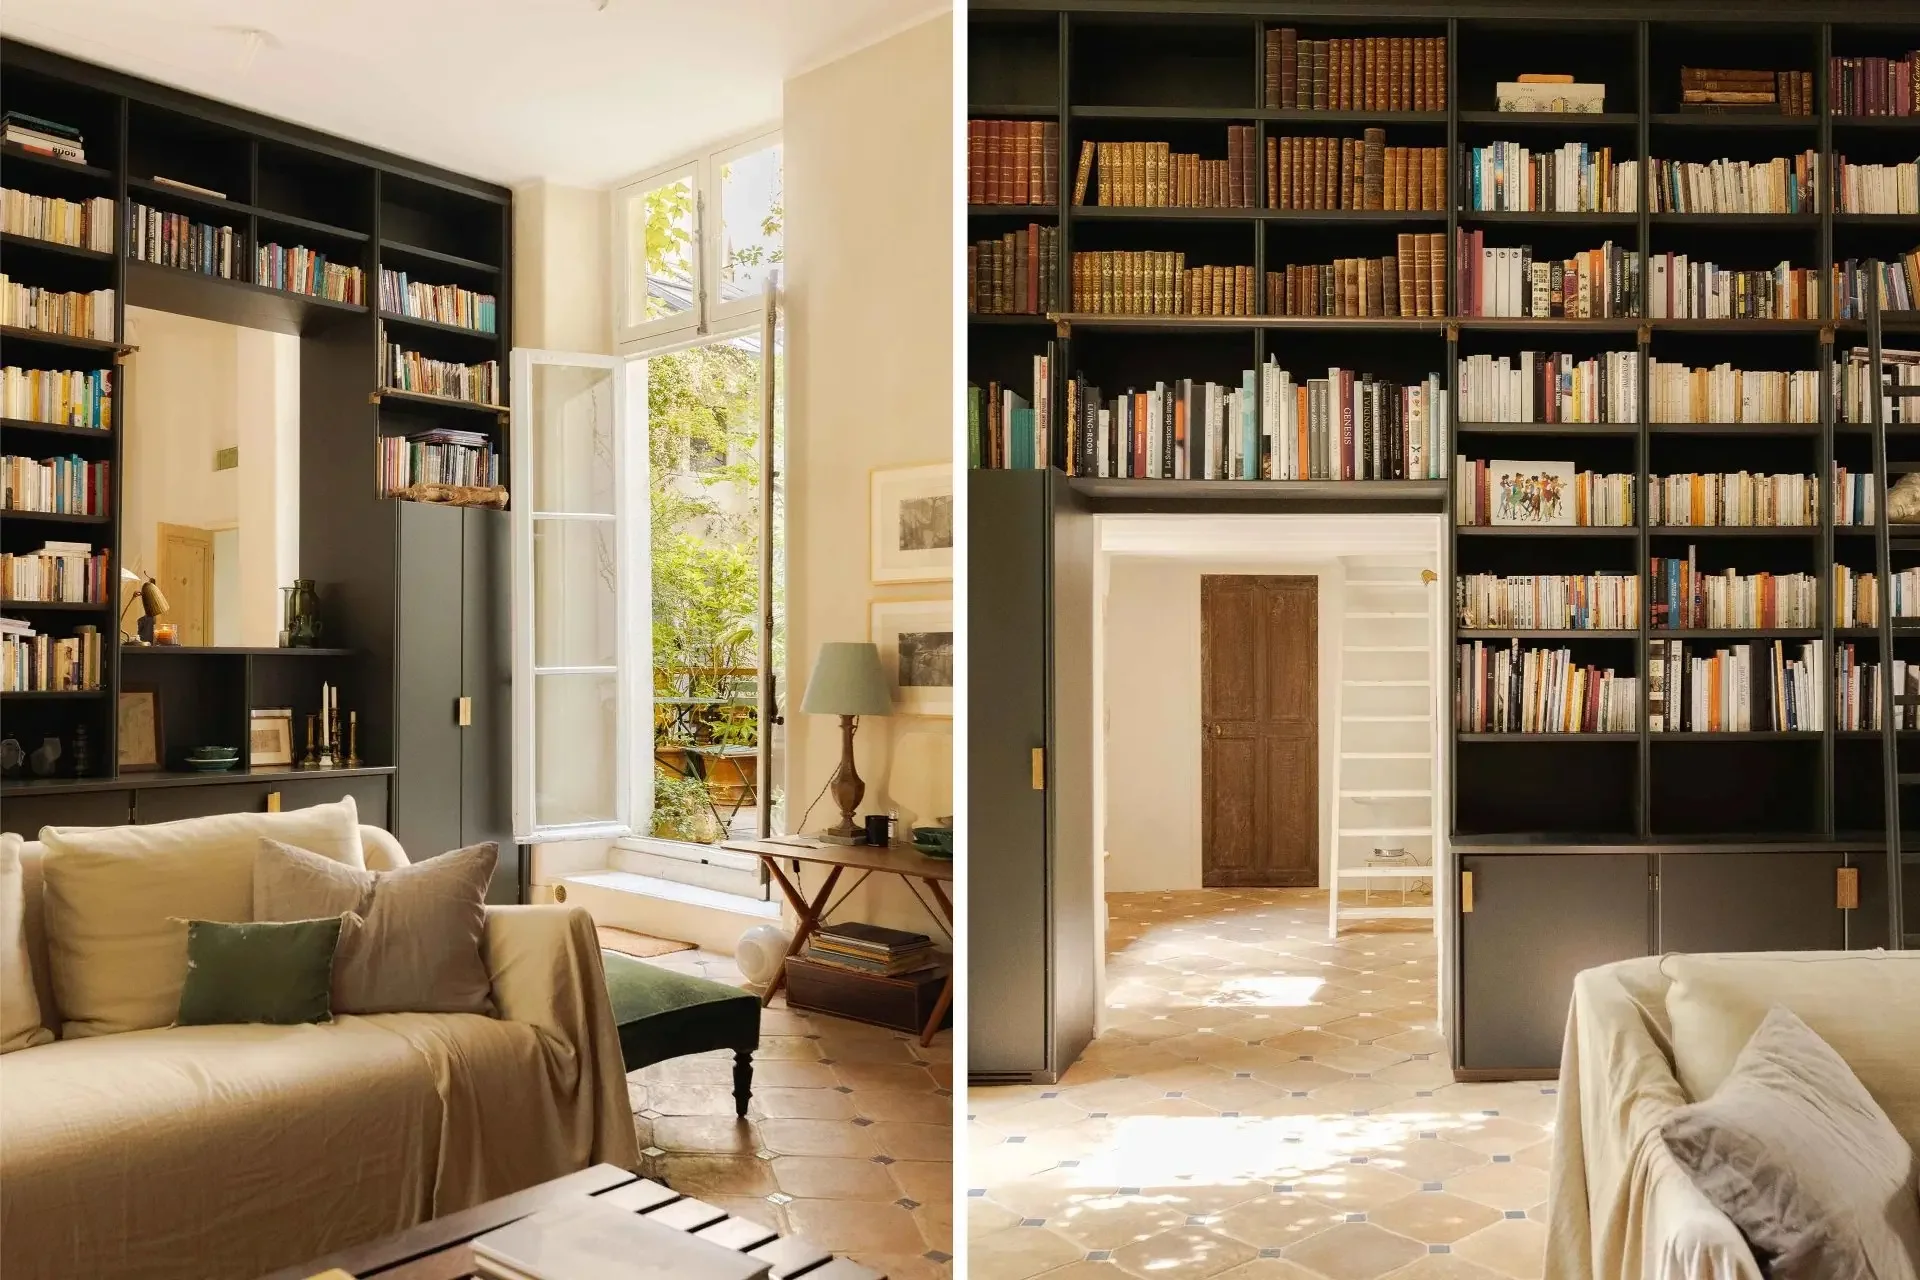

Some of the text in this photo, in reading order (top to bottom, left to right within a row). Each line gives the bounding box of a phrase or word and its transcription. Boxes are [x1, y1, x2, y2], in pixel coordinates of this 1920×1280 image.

[1166, 391, 1174, 414] images
[1343, 407, 1352, 445] GENESIS
[1363, 396, 1371, 462] ATLAS MONDIAL
[1165, 460, 1172, 469] La
